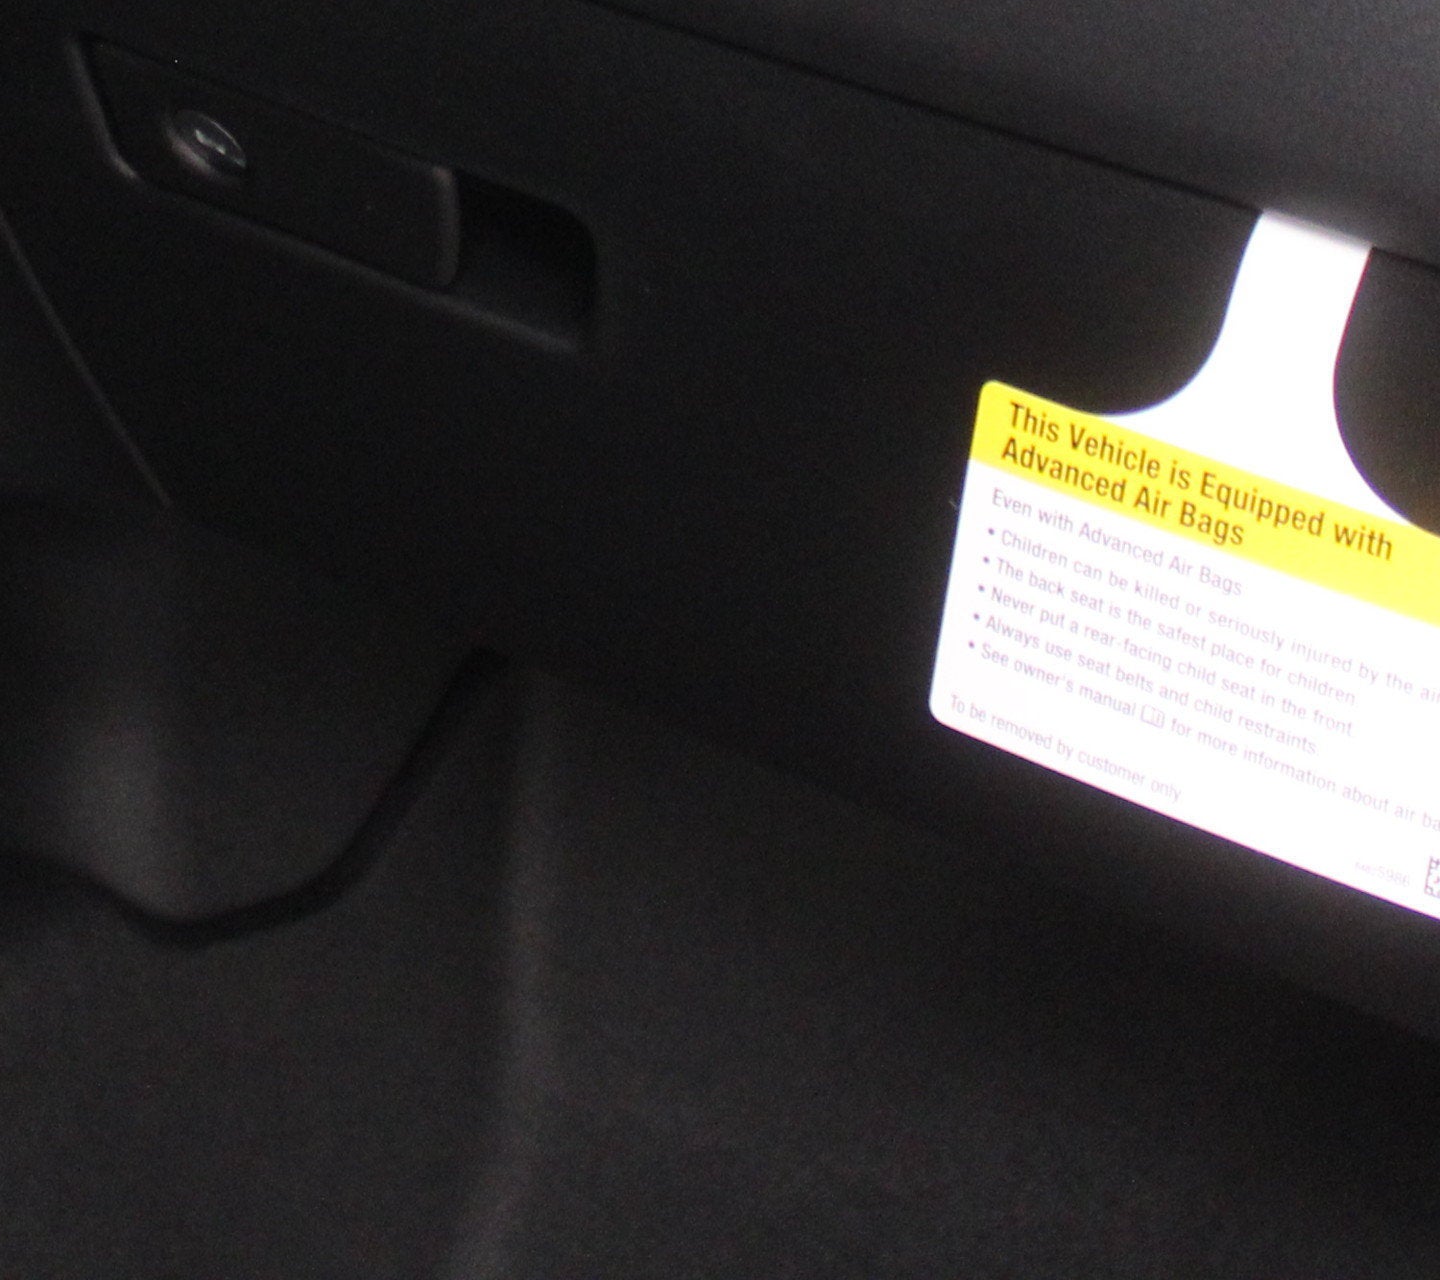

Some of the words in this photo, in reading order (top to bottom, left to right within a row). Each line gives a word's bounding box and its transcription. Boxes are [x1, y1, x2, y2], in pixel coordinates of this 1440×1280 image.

[1001, 437, 1128, 504] Advanced
[1133, 485, 1172, 518] Air
[1179, 500, 1245, 546] Bags
[1011, 401, 1060, 443] This
[1069, 422, 1161, 479] Vehicle
[1169, 459, 1192, 490] is
[1200, 471, 1326, 538] Equipped
[1333, 523, 1393, 561] with
[991, 486, 1033, 518] Even
[1037, 508, 1074, 533] with
[1078, 521, 1164, 568] Advanced
[1167, 554, 1194, 575] Air
[1198, 564, 1242, 596] Bags
